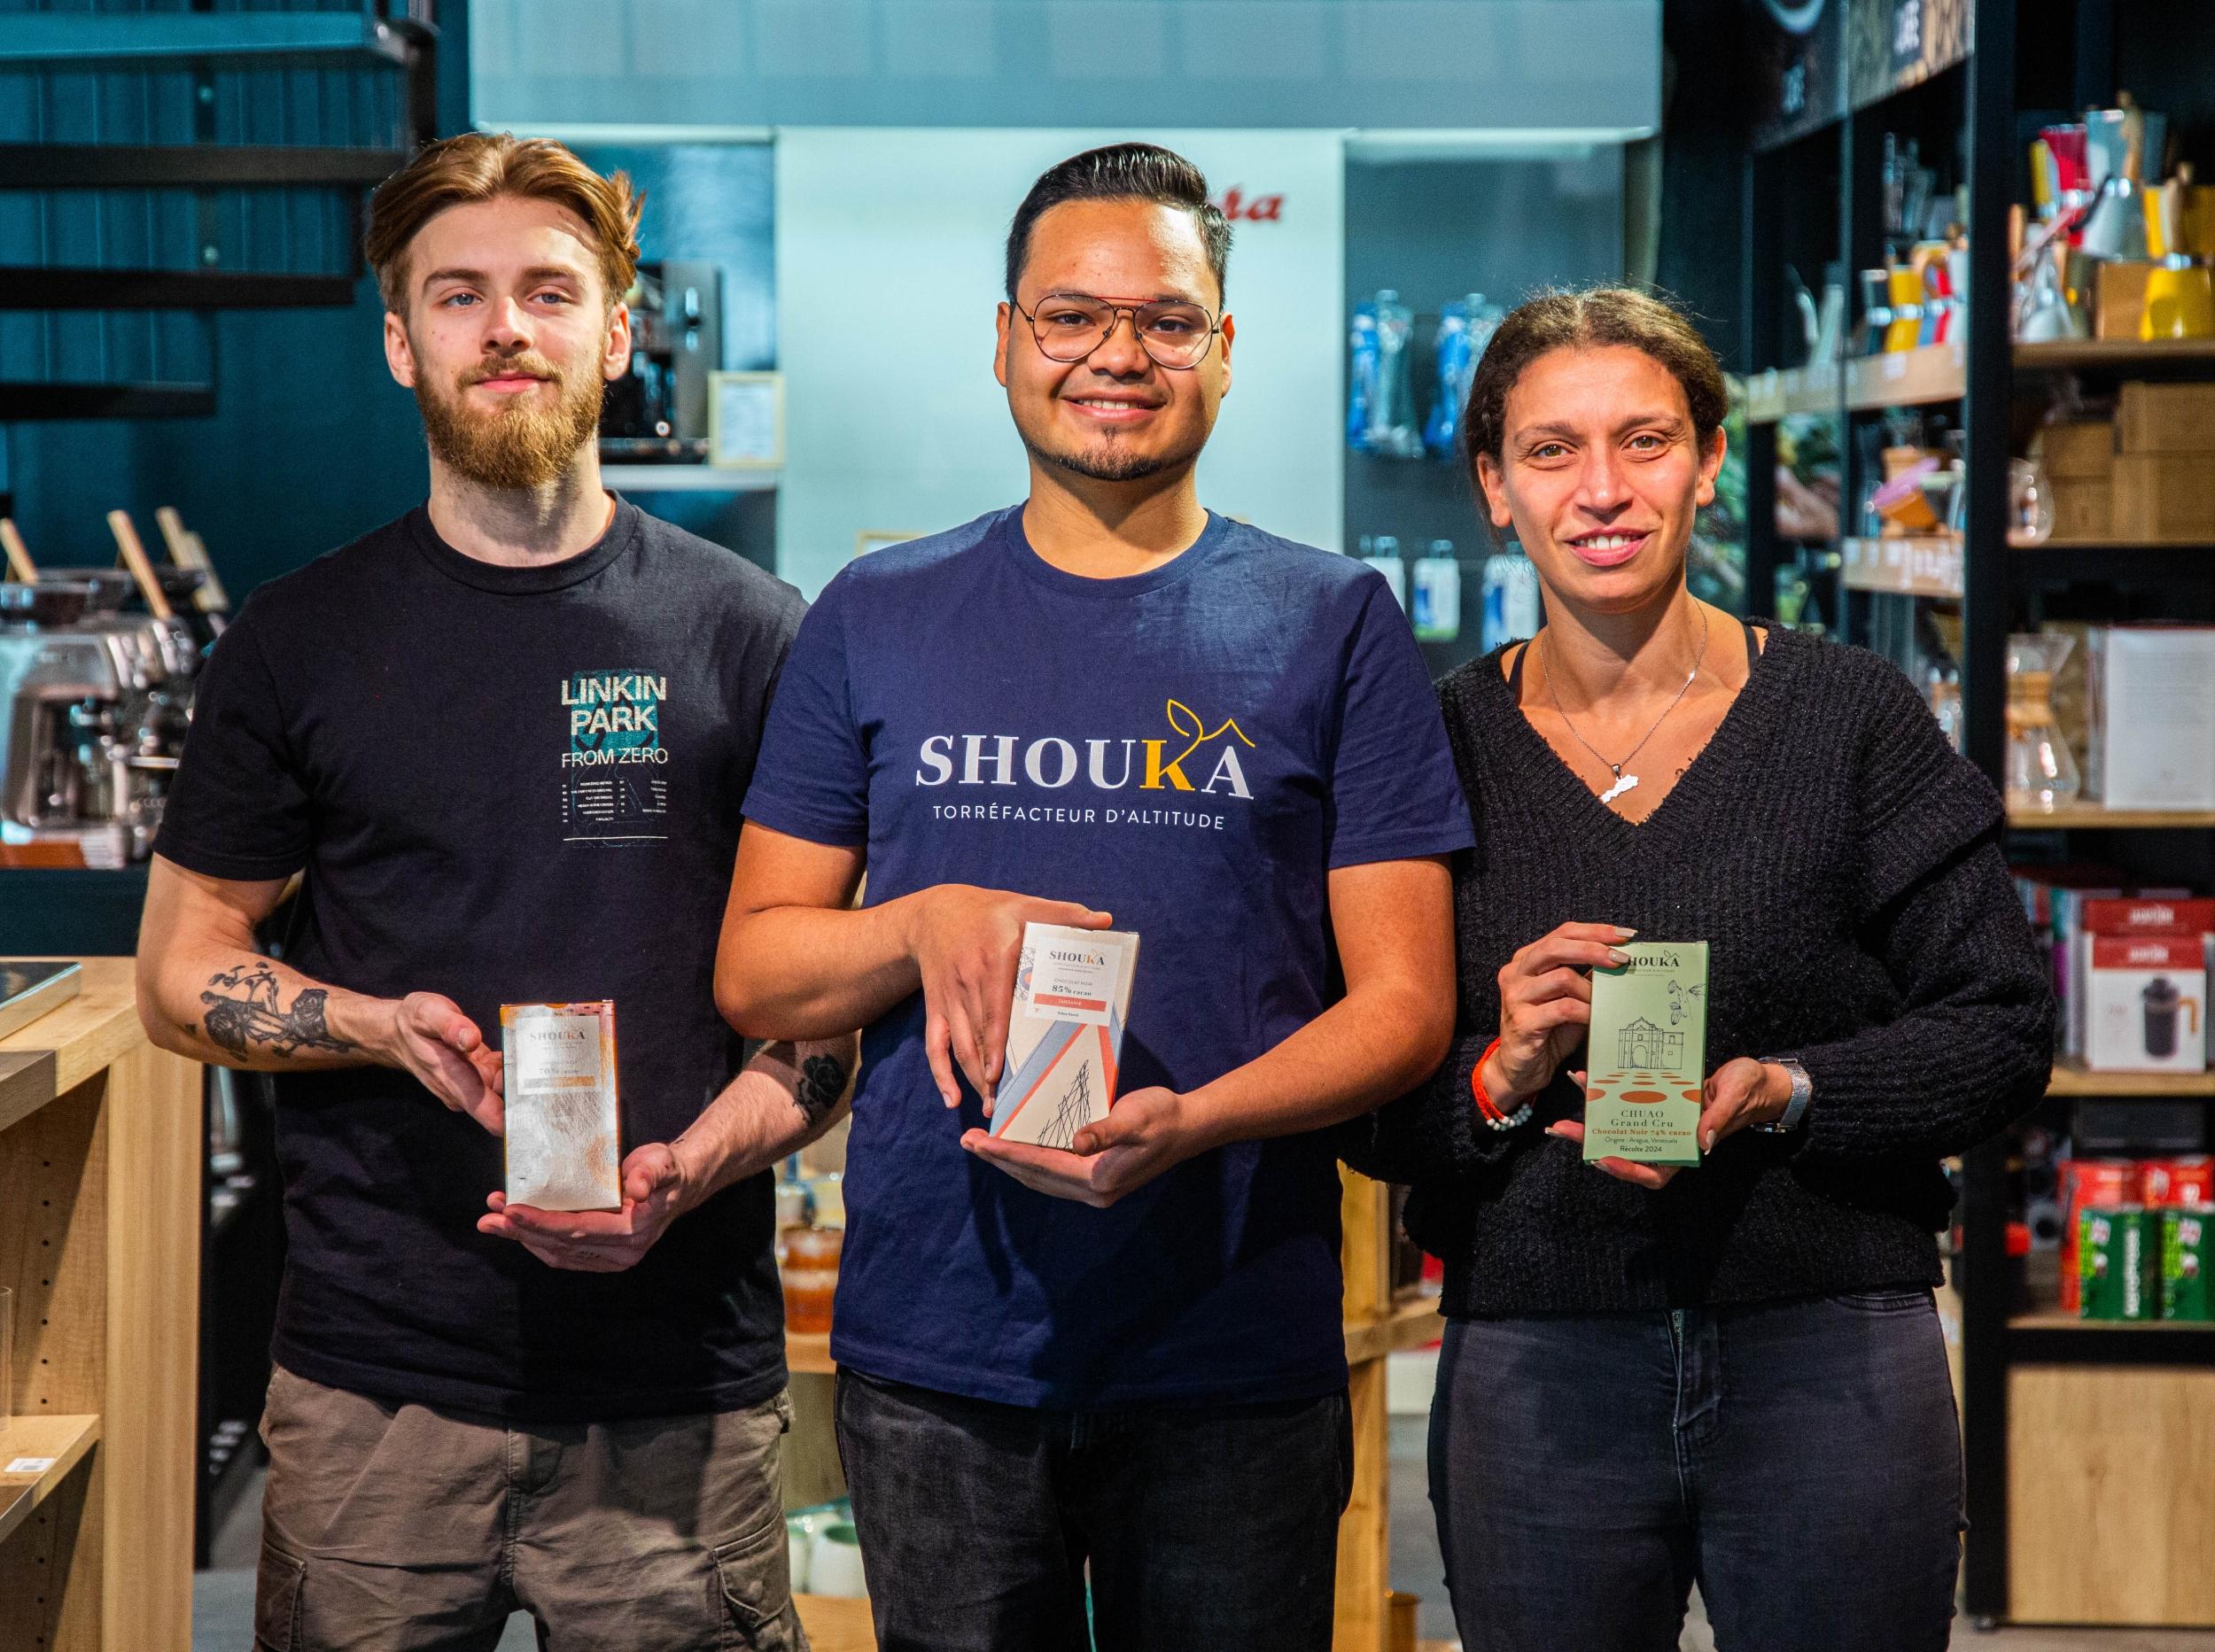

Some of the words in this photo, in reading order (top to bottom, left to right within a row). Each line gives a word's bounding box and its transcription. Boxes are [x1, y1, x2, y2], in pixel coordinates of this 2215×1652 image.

[561, 675, 667, 705] LINKIN
[571, 705, 657, 736] PARK
[562, 748, 615, 769] FROM
[618, 747, 669, 764] ZERO
[915, 732, 1255, 800] SHOUKA
[932, 802, 1095, 824] TORRÉFACTEUR
[1048, 950, 1106, 966] SHOUKA
[1628, 957, 1681, 967] HOUKA
[530, 1030, 587, 1041] SHOUKA
[1611, 1118, 1647, 1127] Grand
[1652, 1119, 1674, 1128] Cru
